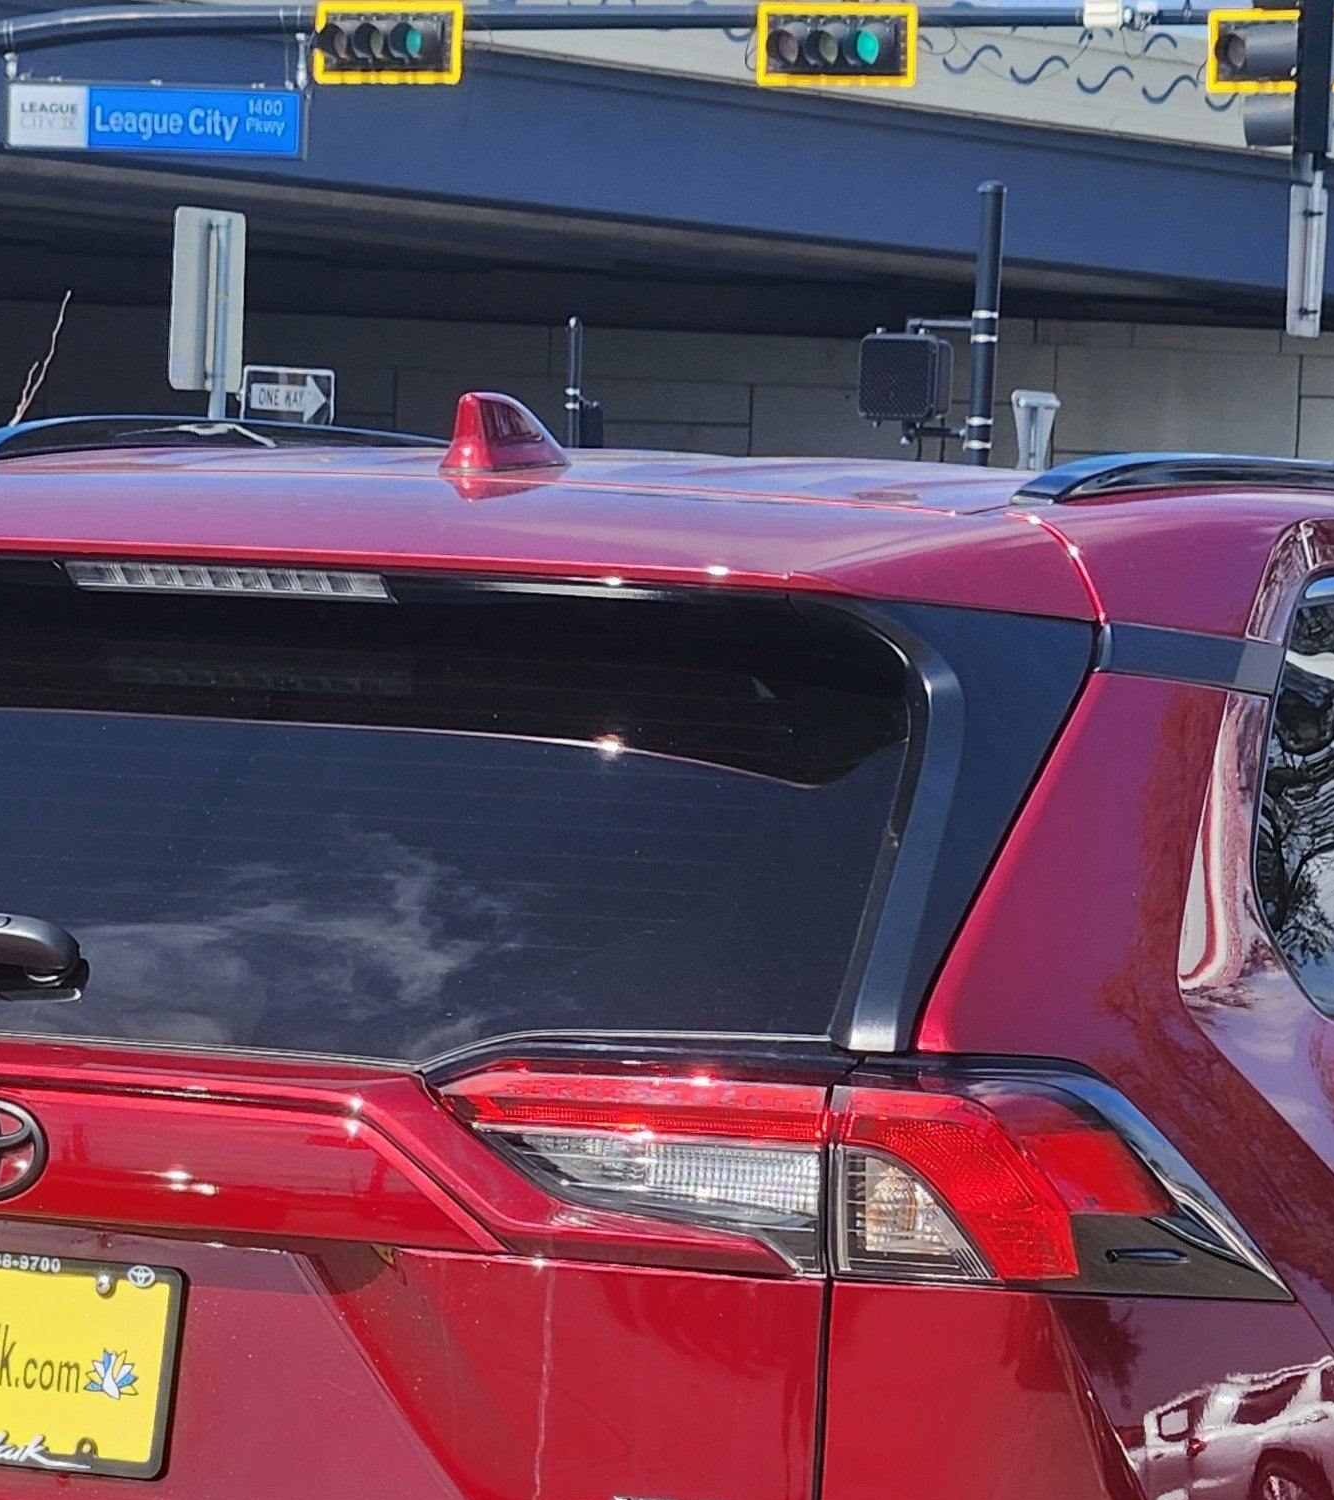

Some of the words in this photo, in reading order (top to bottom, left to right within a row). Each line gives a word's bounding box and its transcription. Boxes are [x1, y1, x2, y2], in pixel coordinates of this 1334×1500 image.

[20, 101, 78, 116] LEAGUE
[247, 98, 283, 117] 1400
[94, 104, 184, 141] League
[188, 107, 239, 142] City
[245, 117, 285, 137] Pkwy
[258, 387, 280, 407] ONE
[284, 388, 305, 408] WAY
